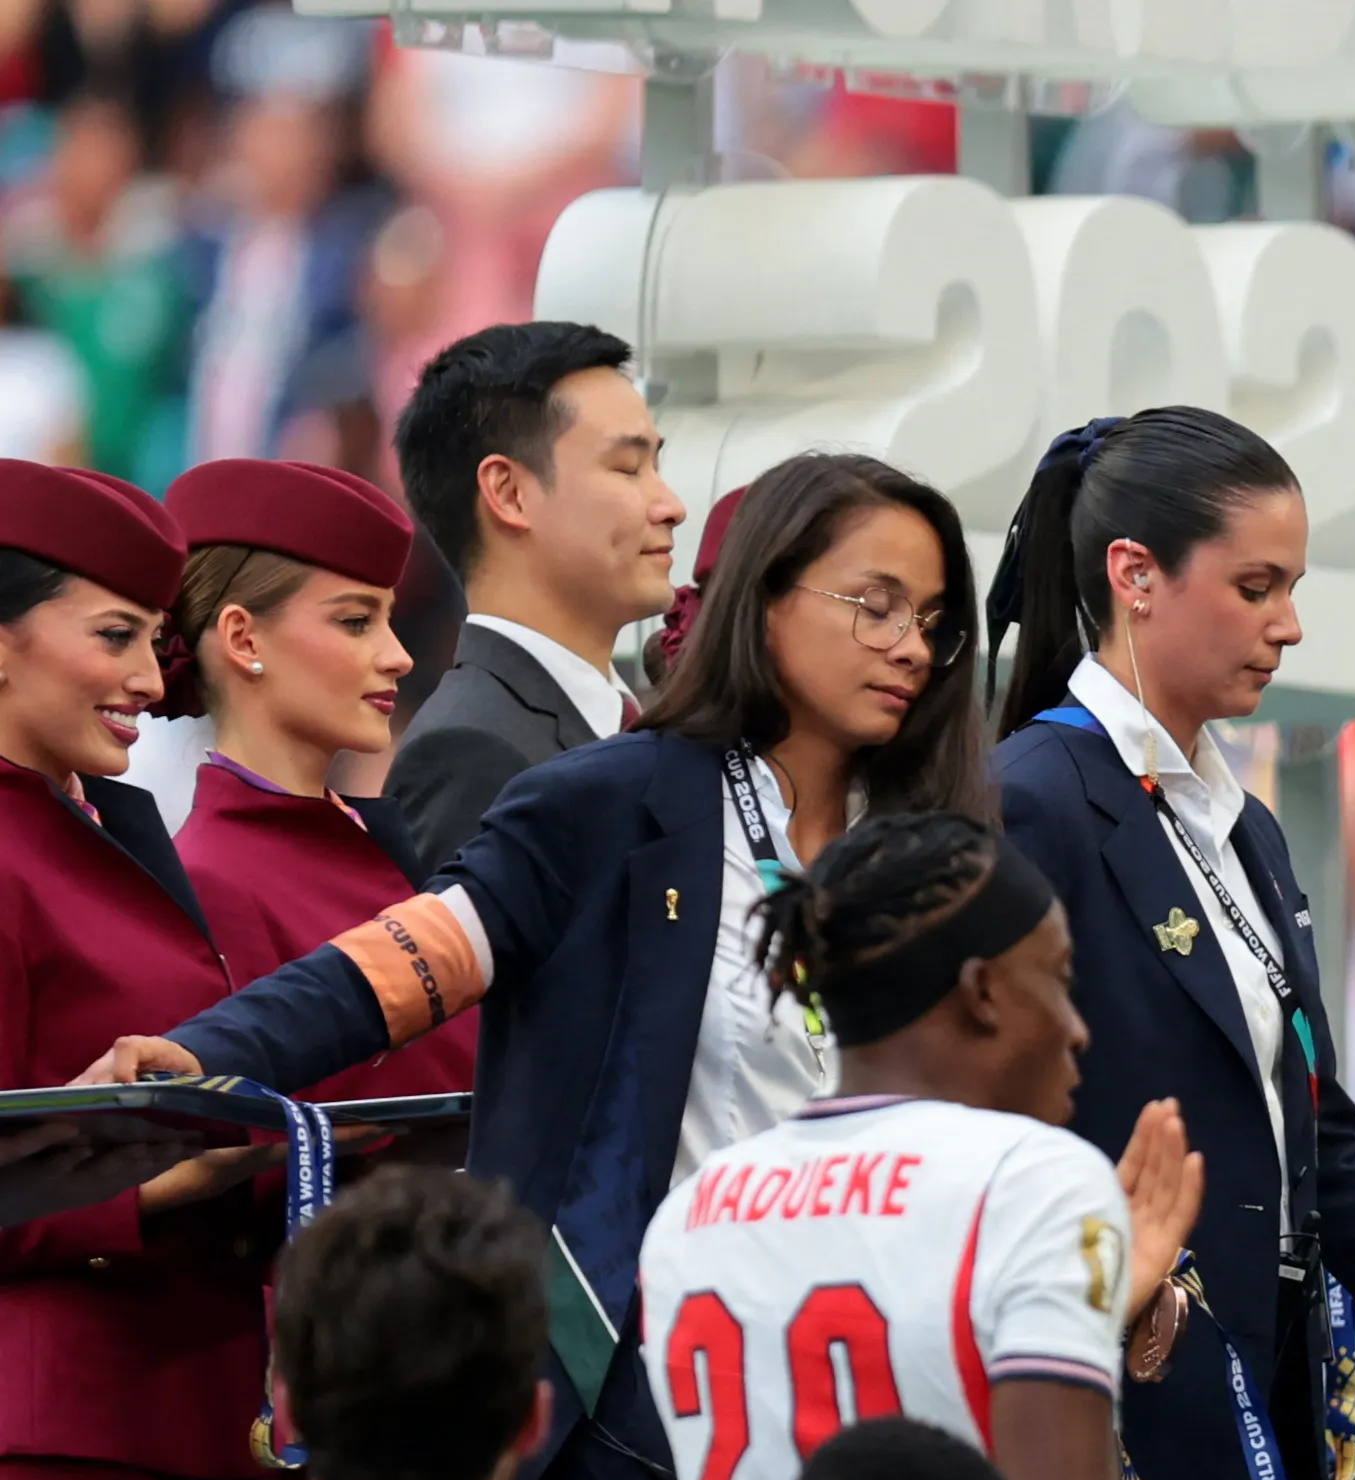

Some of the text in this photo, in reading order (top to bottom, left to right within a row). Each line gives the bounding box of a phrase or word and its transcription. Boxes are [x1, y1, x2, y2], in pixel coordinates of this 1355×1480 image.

[724, 749, 765, 840] CUP 2026
[1208, 873, 1232, 907] CUP
[384, 919, 418, 956] CUP
[1229, 905, 1271, 963] WORLD
[1265, 960, 1292, 998] FIFA
[297, 1126, 314, 1201] WORLD
[684, 1152, 924, 1232] MADUEKE
[1328, 1284, 1346, 1328] FIFA
[1243, 1411, 1267, 1450] CUP
